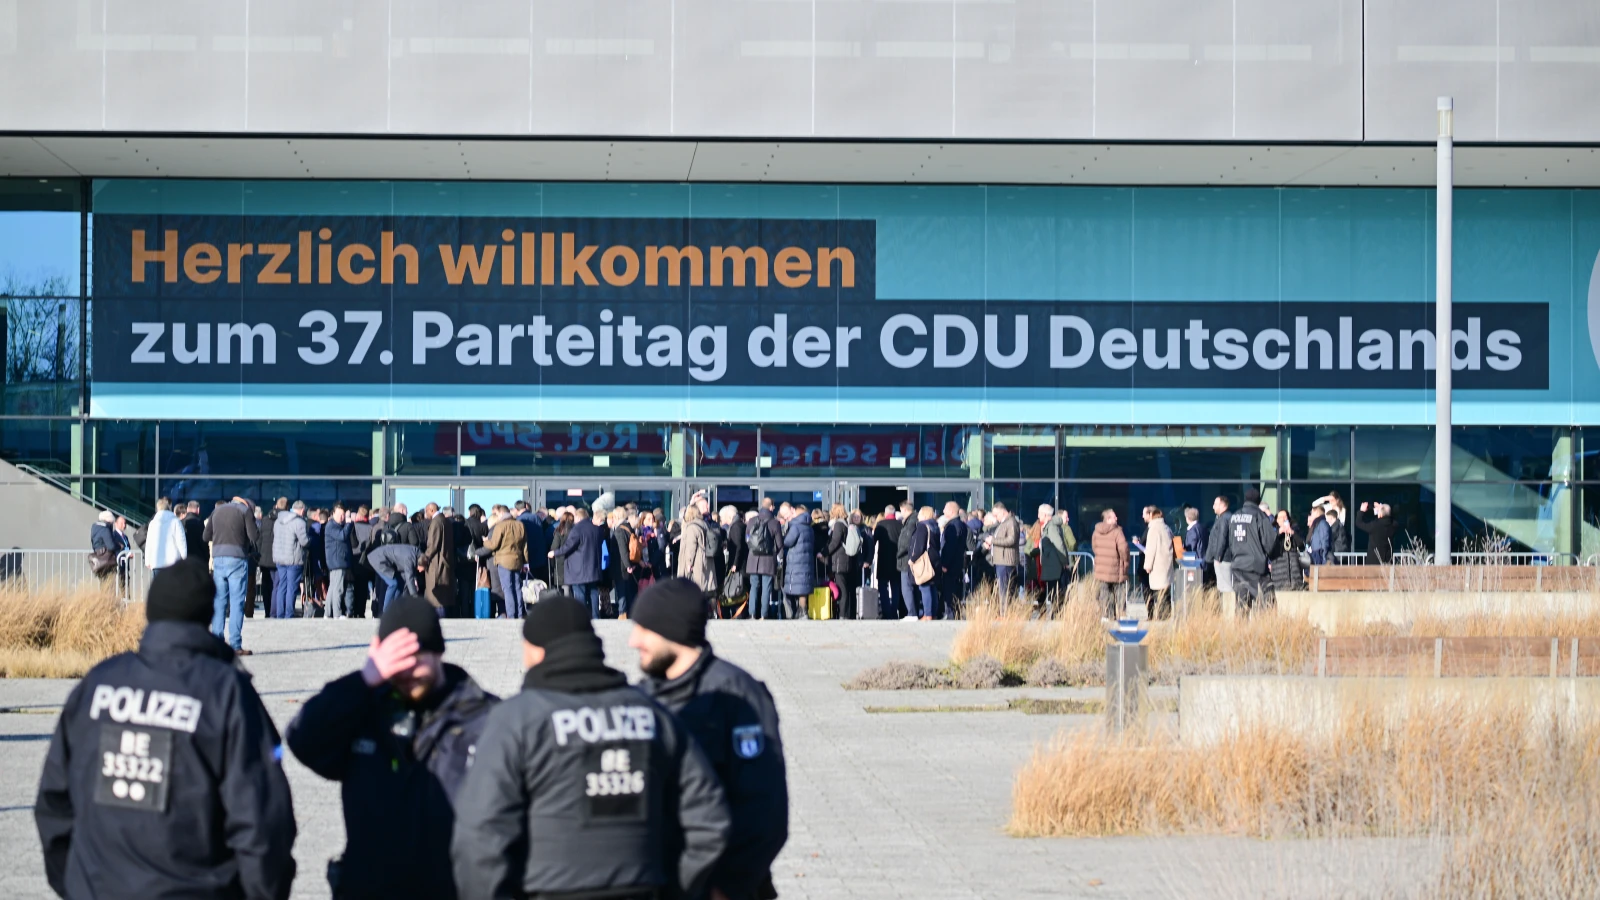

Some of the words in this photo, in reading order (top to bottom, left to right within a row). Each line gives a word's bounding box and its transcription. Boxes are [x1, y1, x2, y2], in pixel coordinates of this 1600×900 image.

[130, 228, 420, 285] Herzlich
[439, 229, 856, 288] willkommen
[130, 322, 277, 365] zum
[297, 309, 394, 366] 37.
[412, 309, 728, 382] Parteitag
[747, 313, 863, 369] der
[879, 313, 1029, 370] CDU
[1050, 315, 1523, 372] Deutschlands
[89, 684, 203, 734] POLIZEI
[551, 705, 656, 747] POLIZEI
[120, 729, 151, 758] BE
[600, 748, 631, 773] BE
[102, 751, 164, 784] 35322
